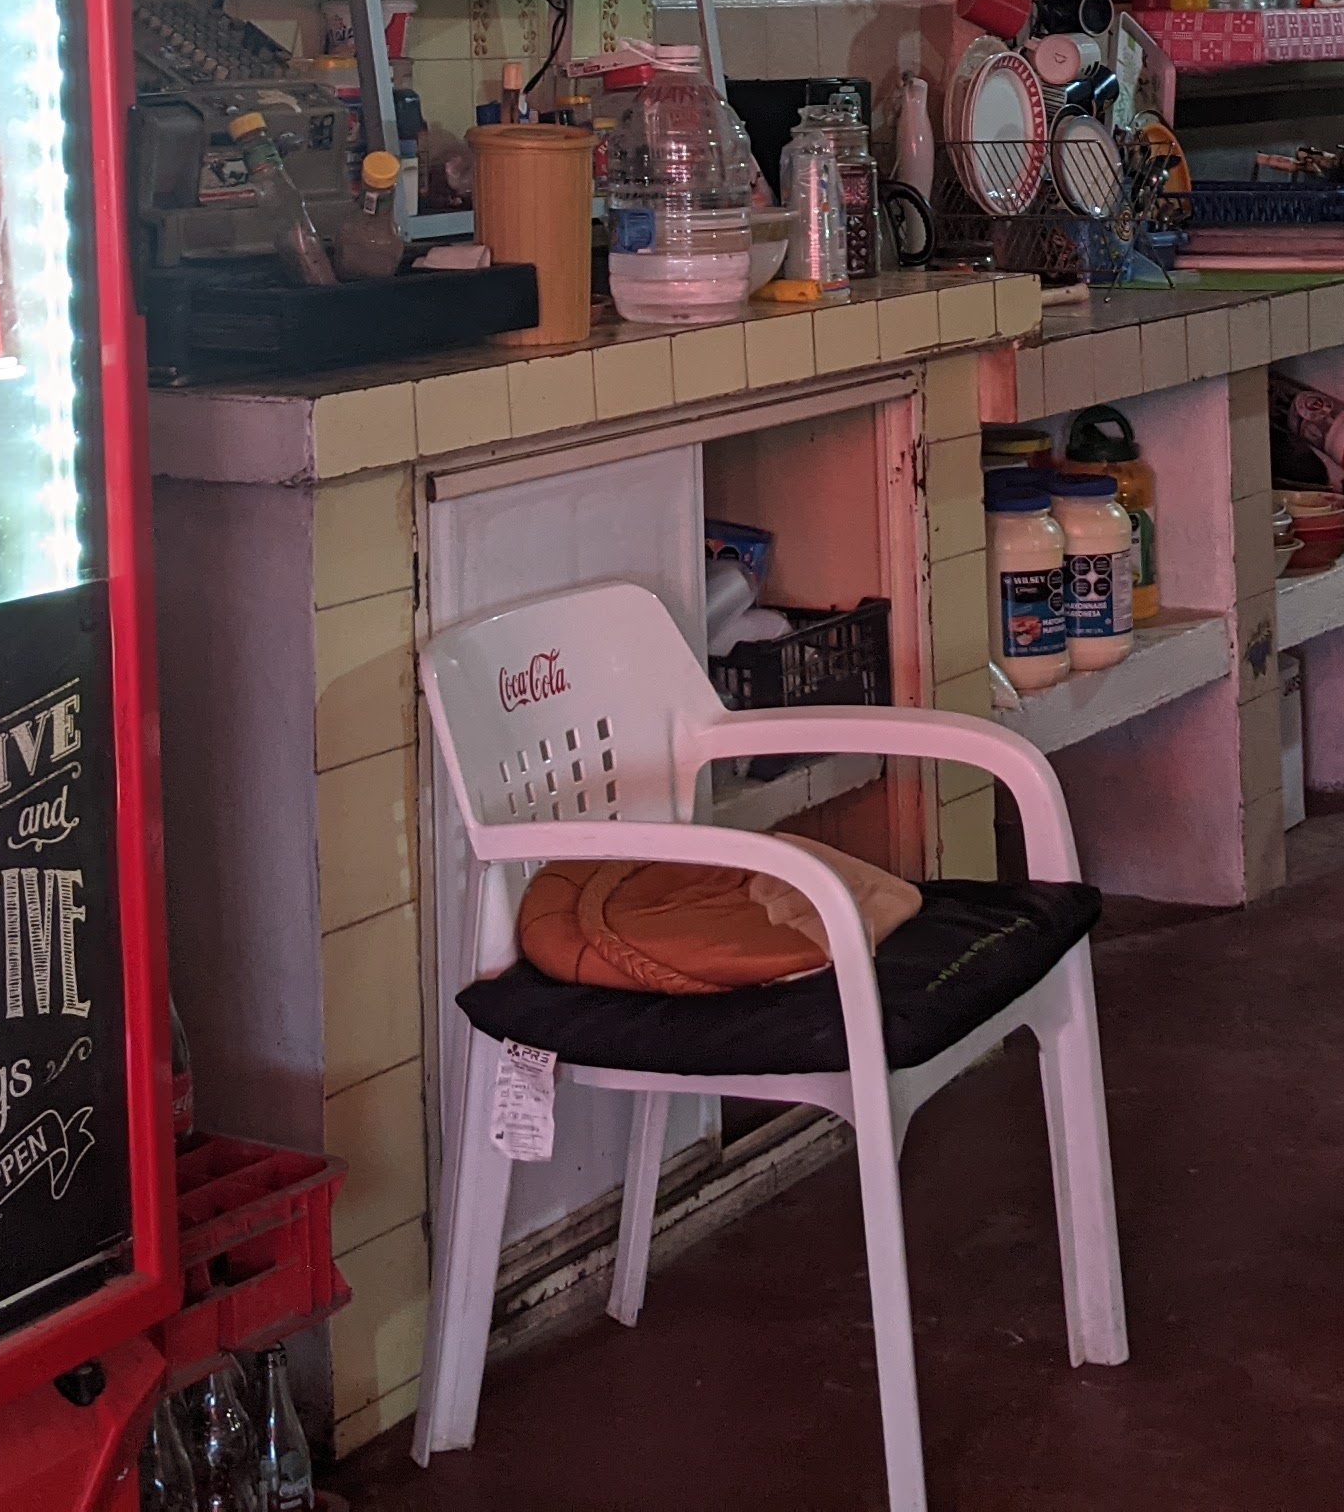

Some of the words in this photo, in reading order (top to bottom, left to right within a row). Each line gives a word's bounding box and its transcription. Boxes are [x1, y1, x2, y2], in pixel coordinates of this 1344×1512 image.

[1013, 575, 1046, 585] WILSEY
[499, 648, 570, 712] Coca-Cola
[18, 785, 80, 838] and
